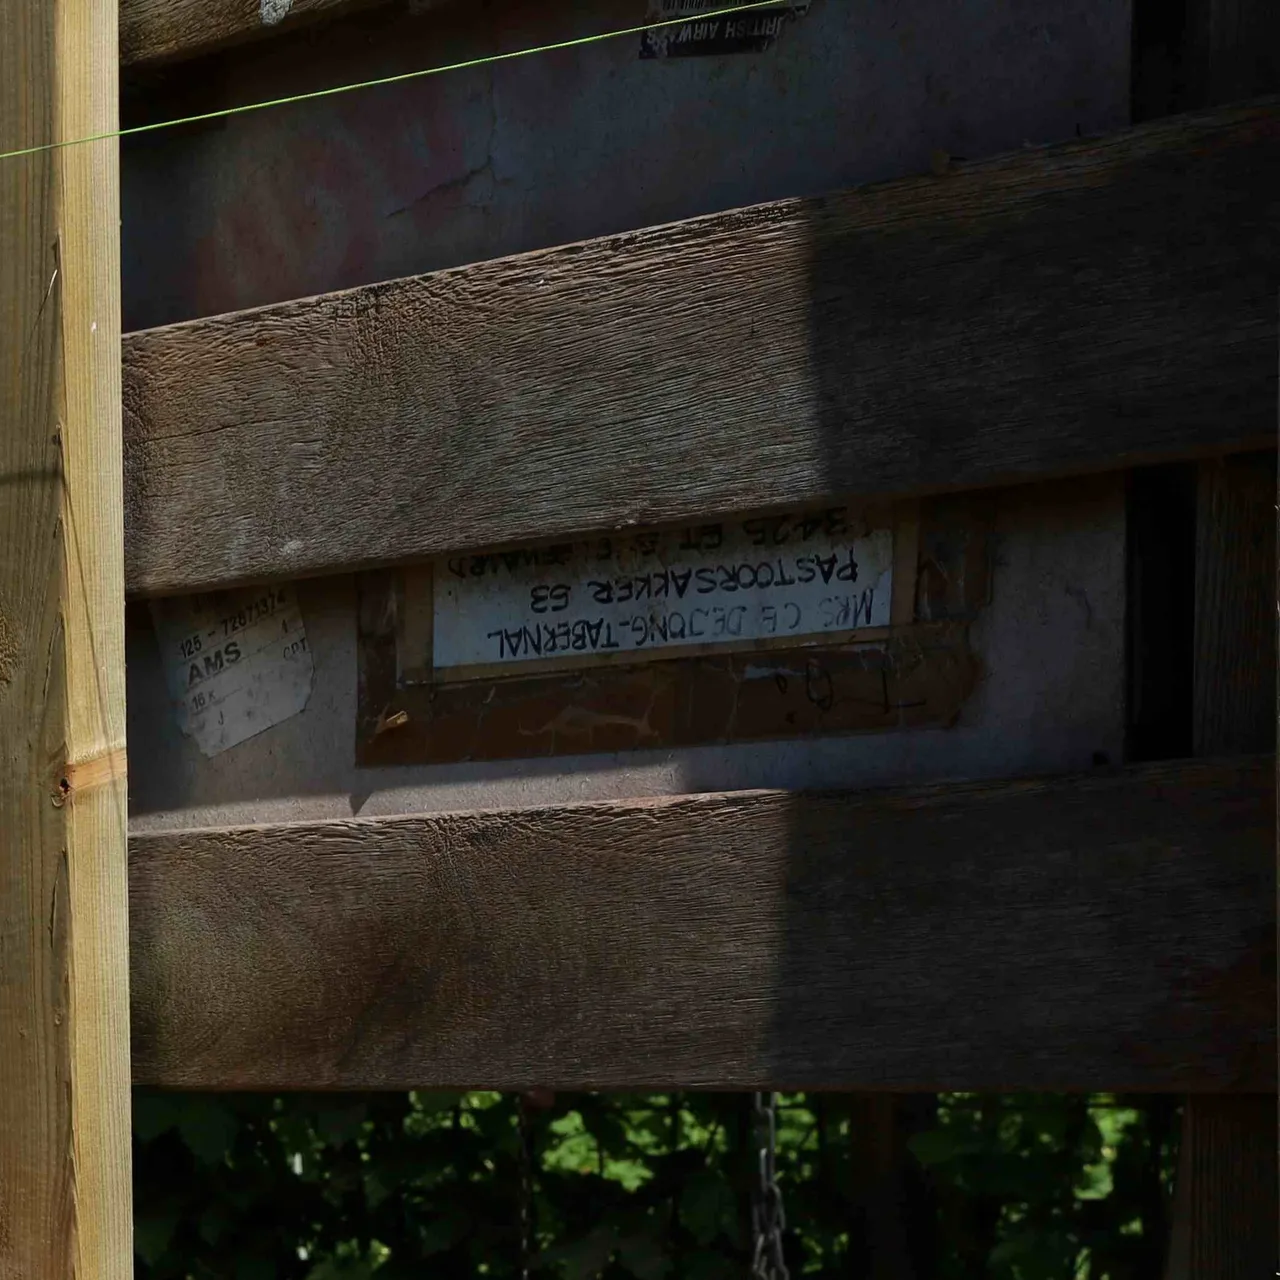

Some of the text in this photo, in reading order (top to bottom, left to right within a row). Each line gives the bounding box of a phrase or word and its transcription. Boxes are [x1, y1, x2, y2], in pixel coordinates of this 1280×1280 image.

[530, 548, 859, 613] PASTOORSAKKER 53
[188, 641, 241, 686] AMS
